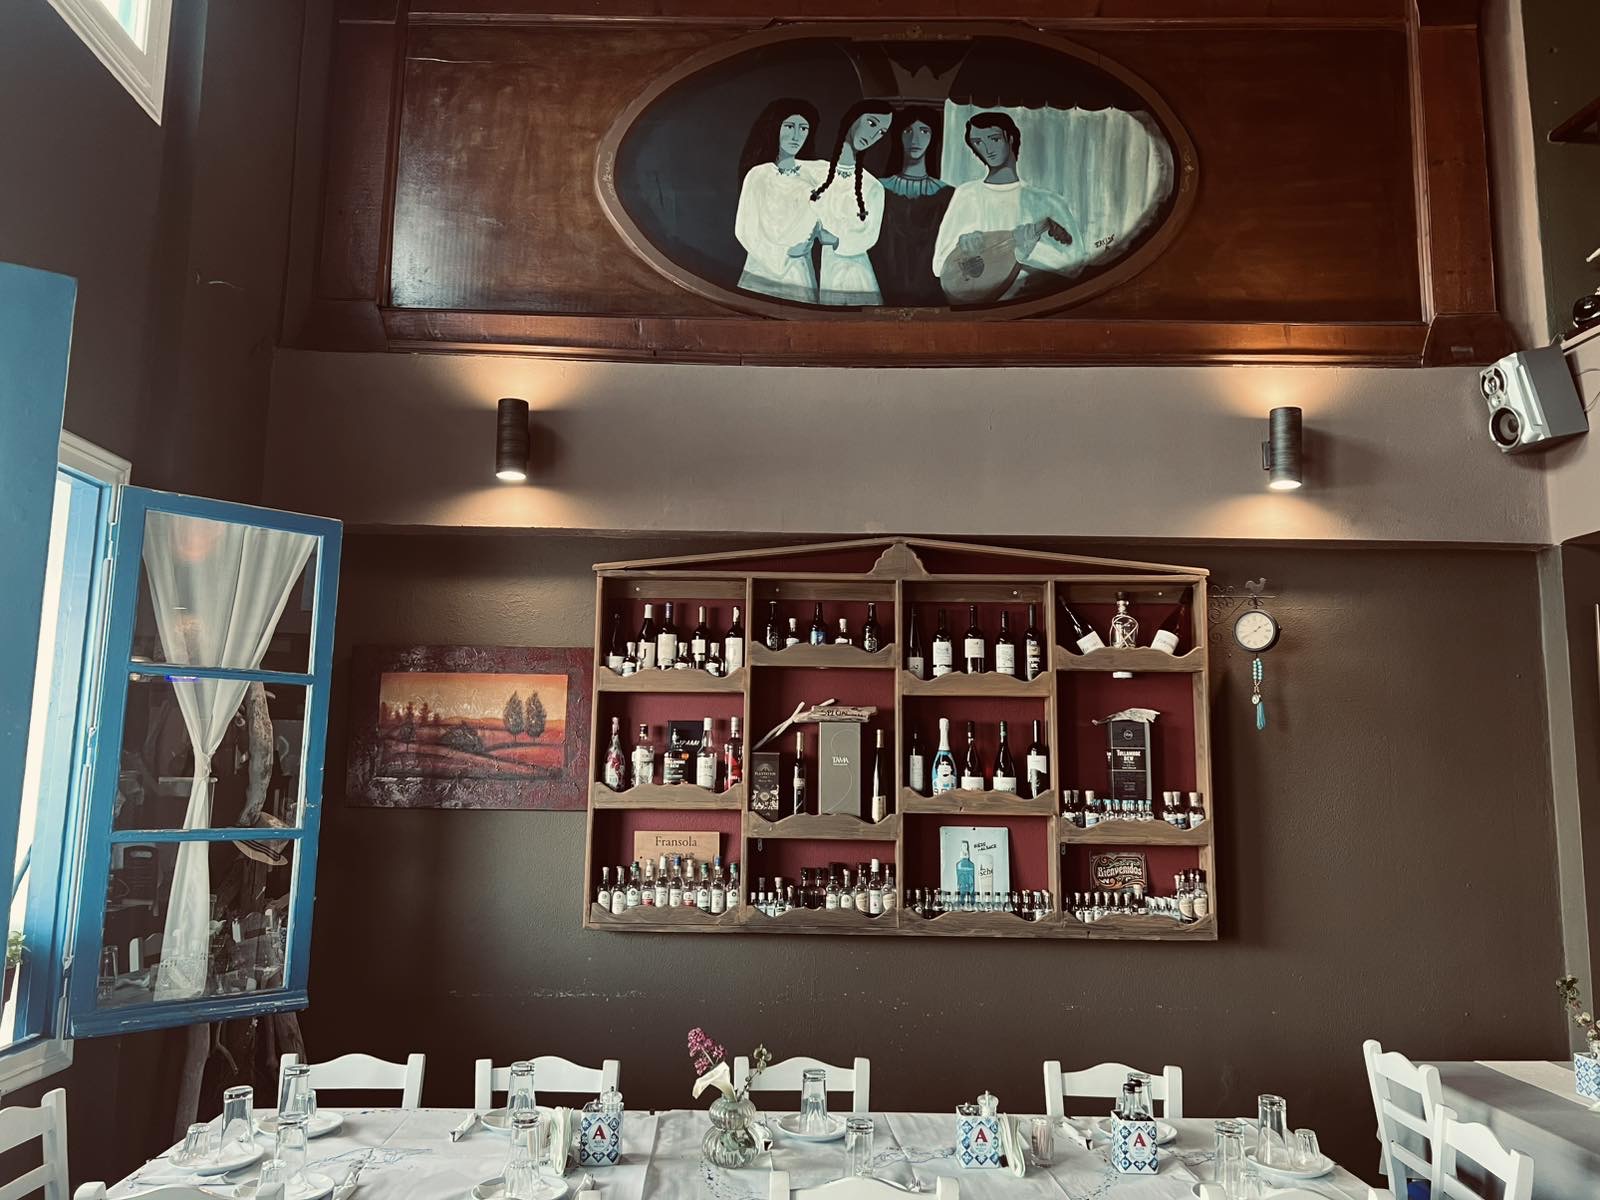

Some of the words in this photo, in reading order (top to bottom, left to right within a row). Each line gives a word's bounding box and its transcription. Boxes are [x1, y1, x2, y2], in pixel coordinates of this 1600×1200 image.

[655, 835, 697, 847] Fransola
[1097, 862, 1142, 877] Bienvenidos
[592, 1124, 607, 1140] A
[975, 1128, 988, 1142] A
[1133, 1133, 1147, 1147] A
